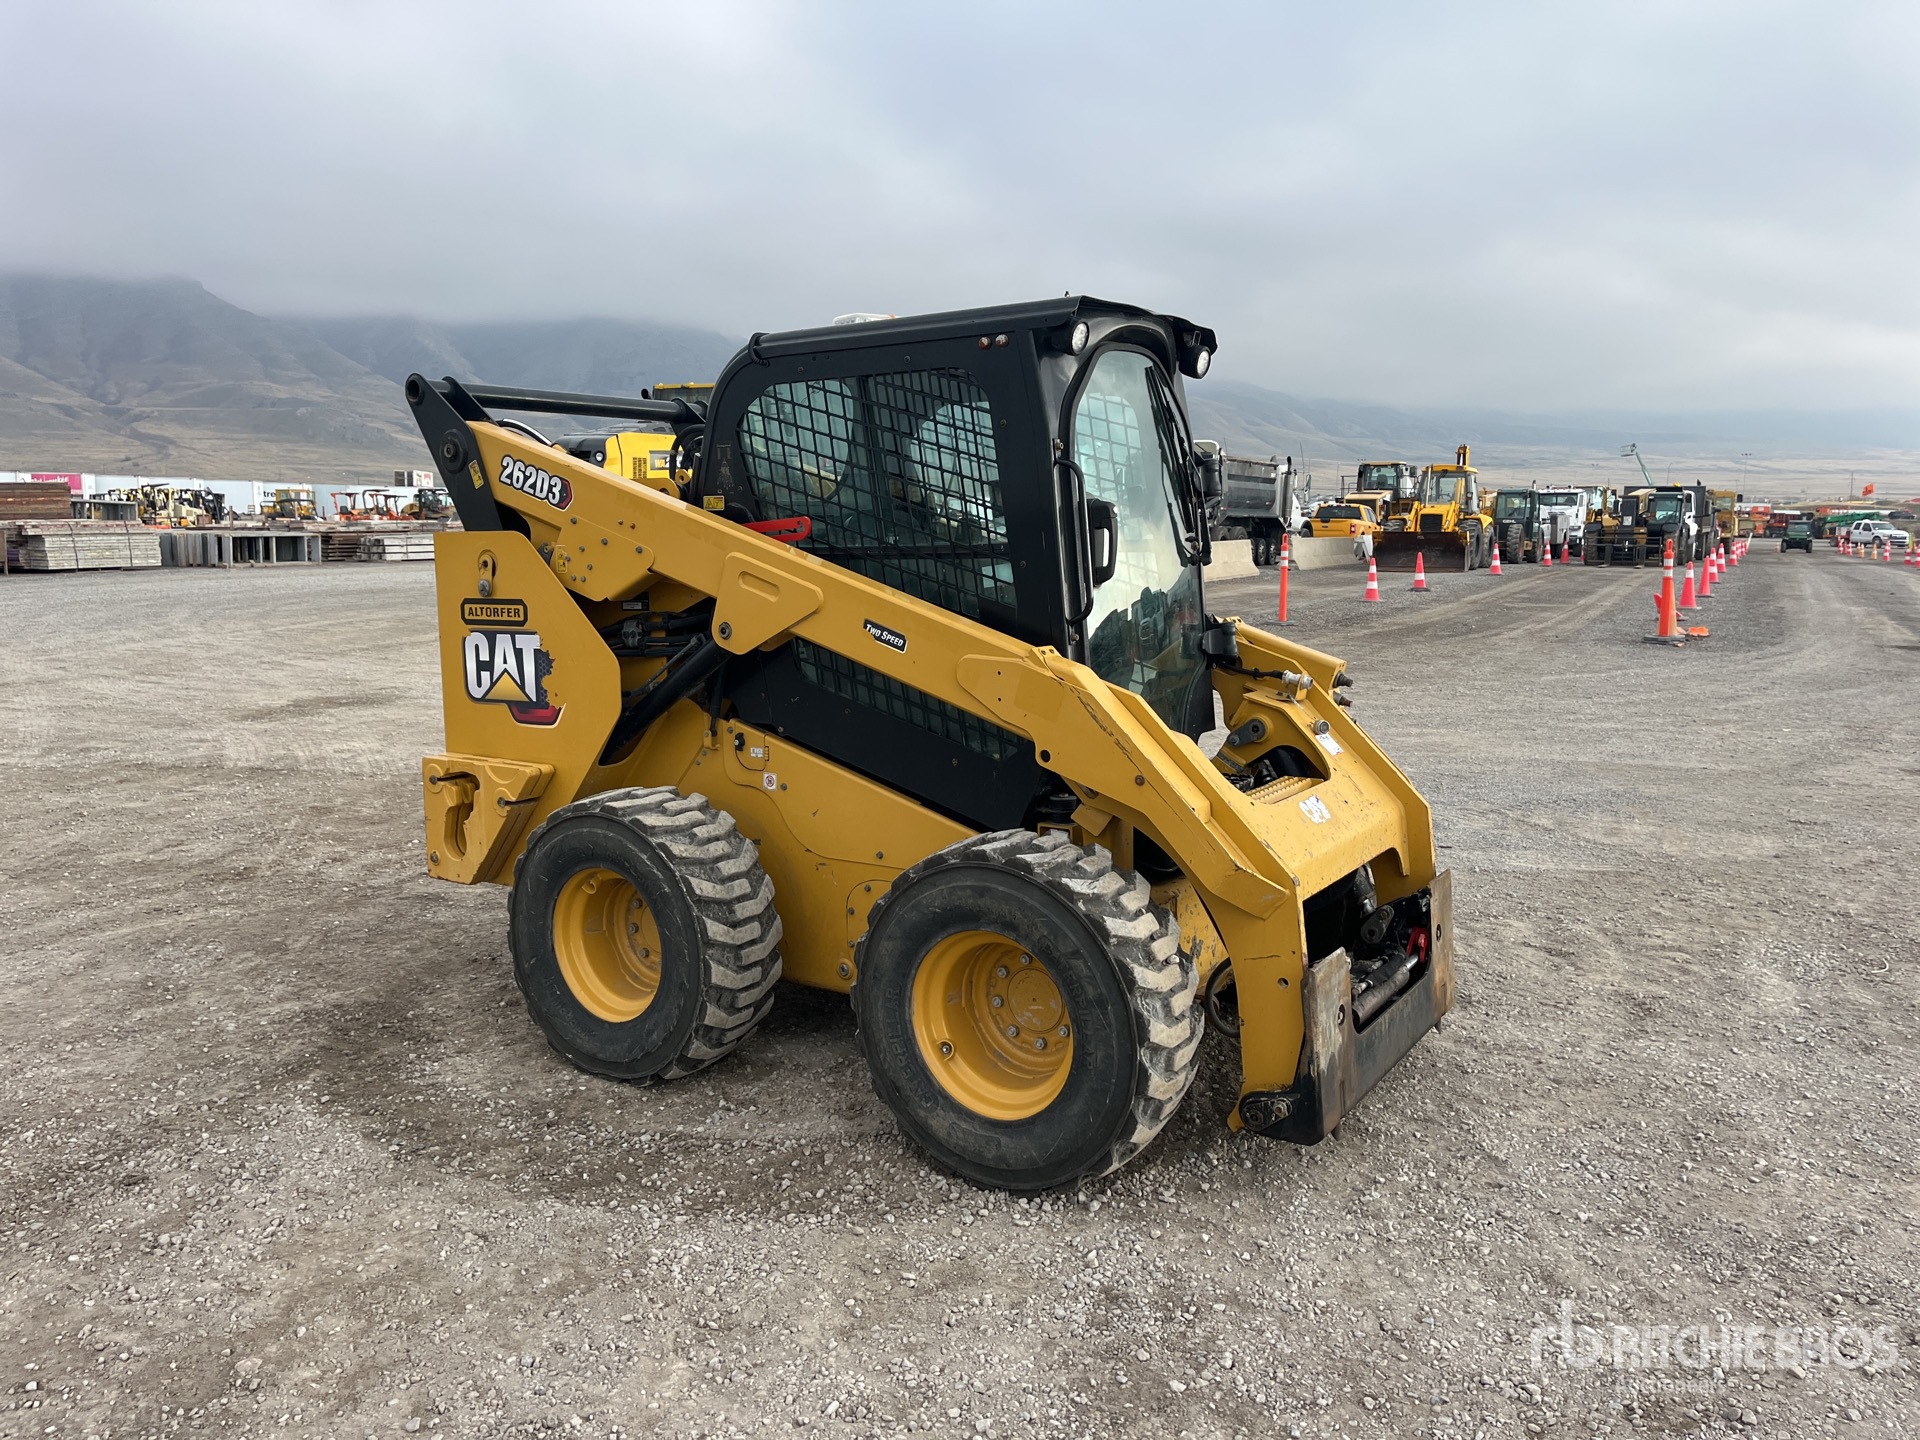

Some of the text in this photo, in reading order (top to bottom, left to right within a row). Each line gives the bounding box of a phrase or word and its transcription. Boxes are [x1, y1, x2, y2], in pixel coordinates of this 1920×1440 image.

[499, 455, 562, 505] 262D3
[467, 606, 521, 618] ALTORFER
[464, 631, 541, 702] CAT
